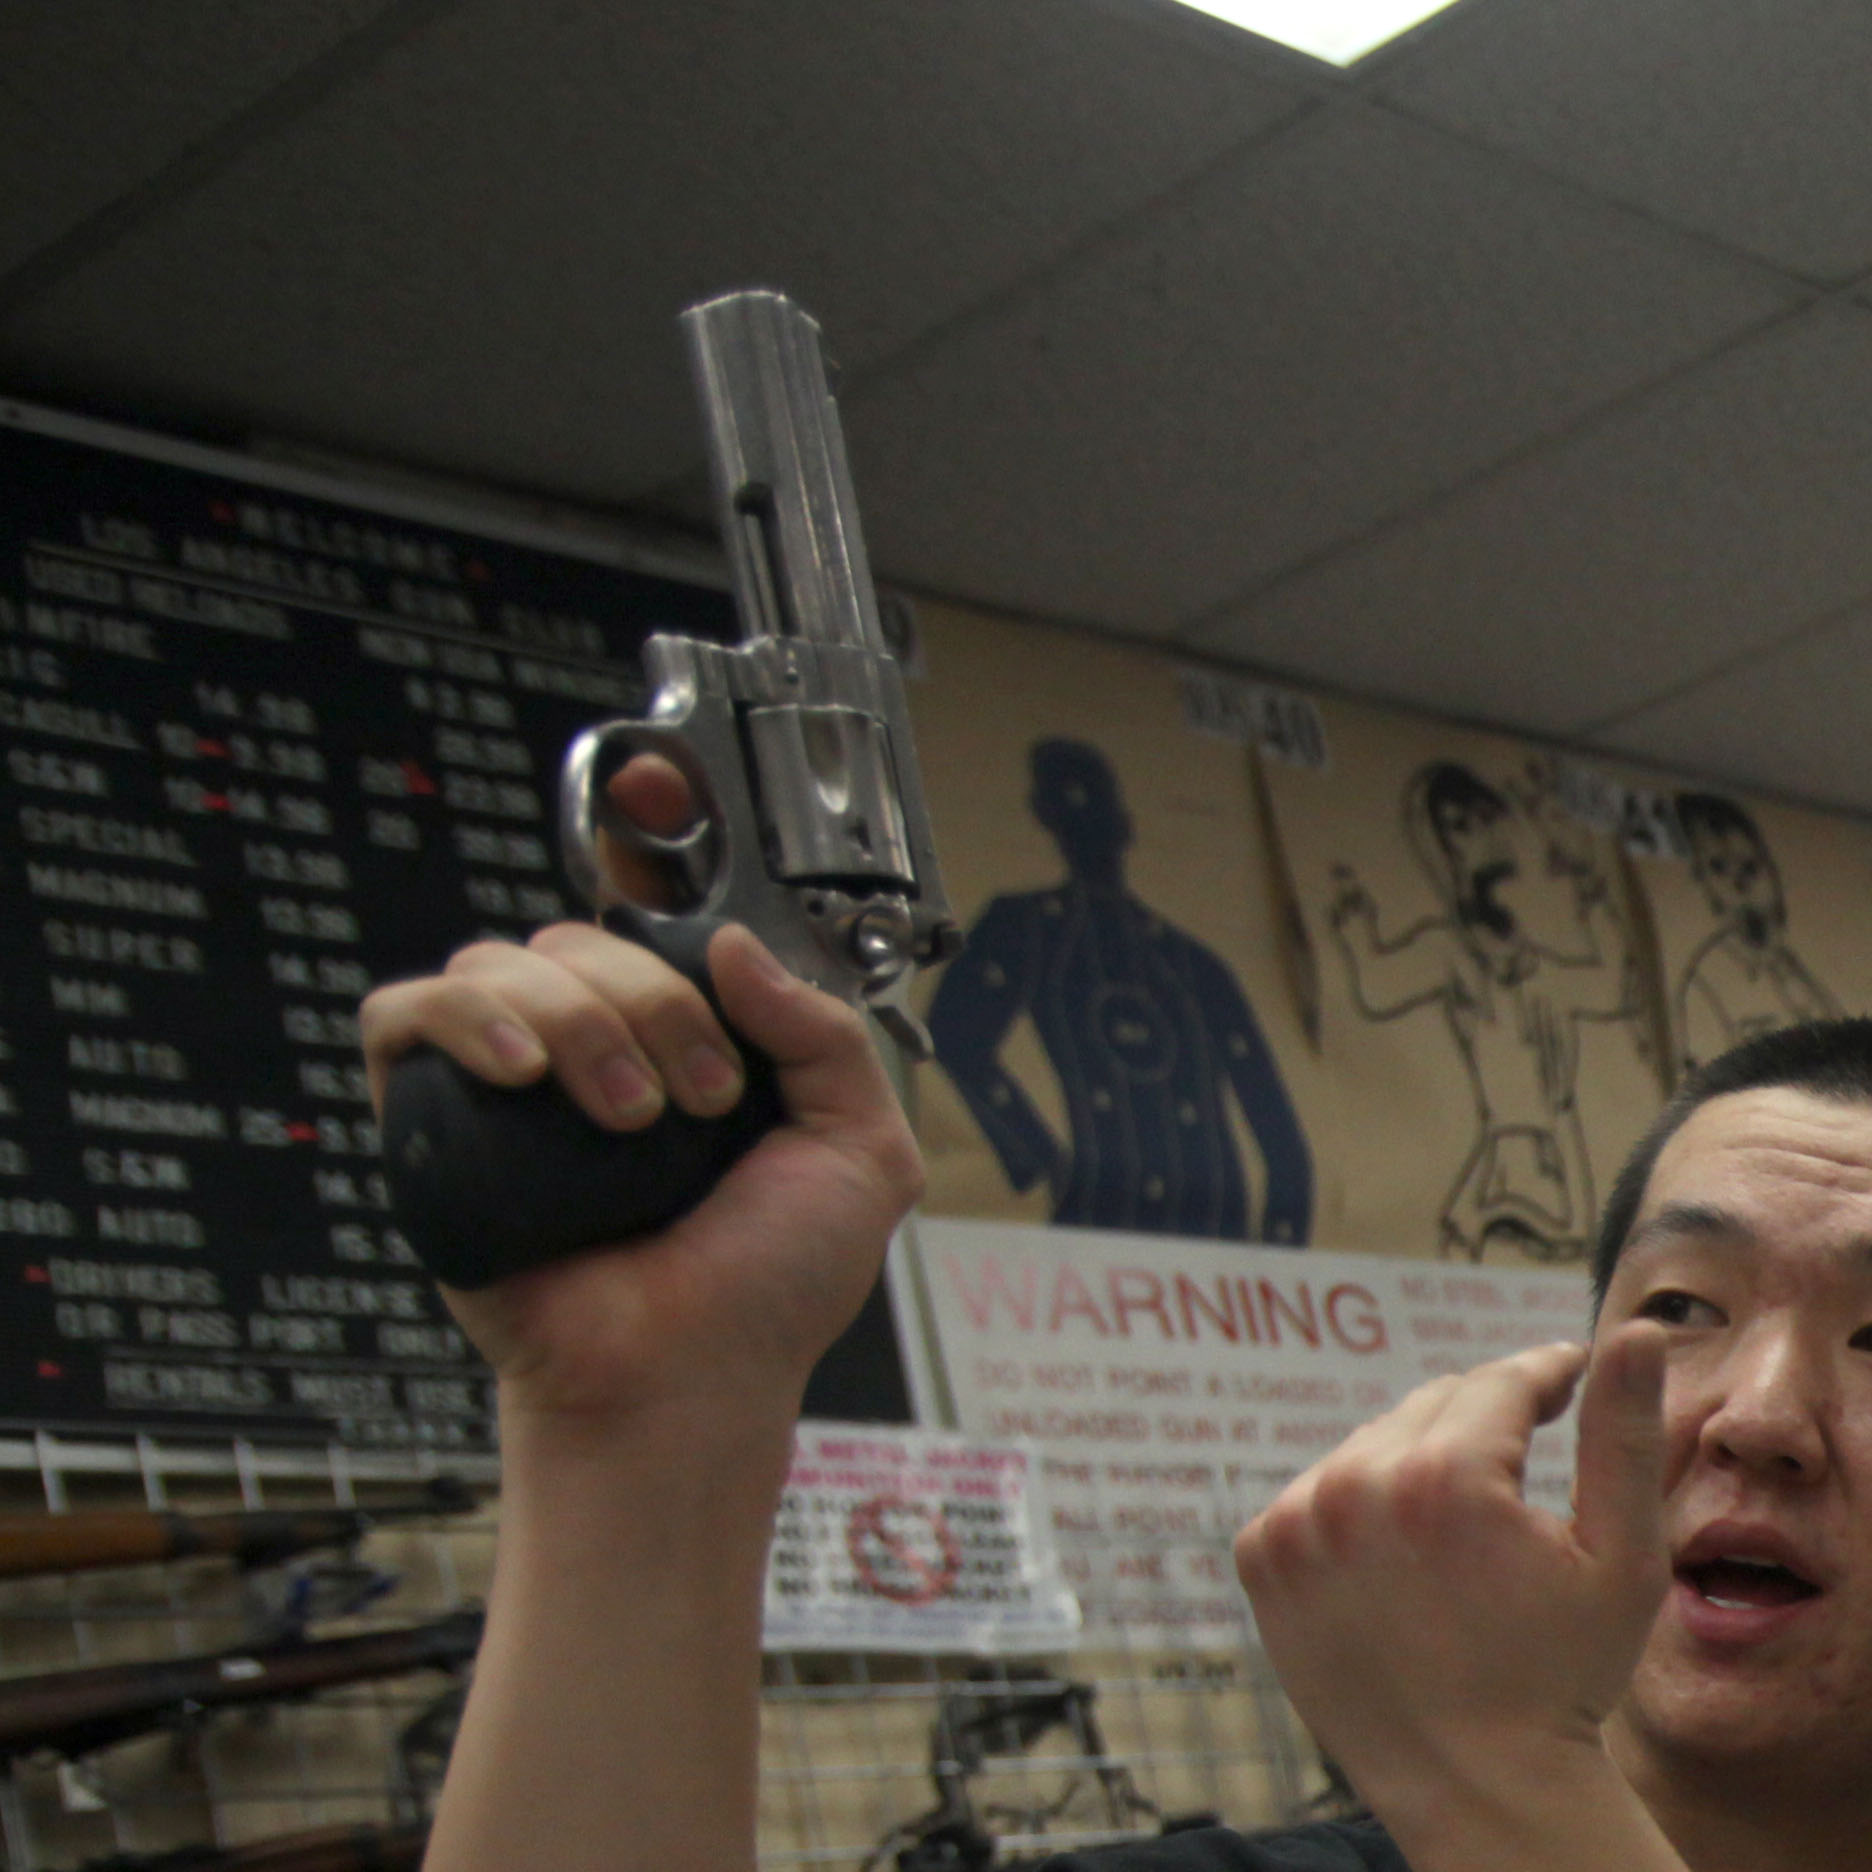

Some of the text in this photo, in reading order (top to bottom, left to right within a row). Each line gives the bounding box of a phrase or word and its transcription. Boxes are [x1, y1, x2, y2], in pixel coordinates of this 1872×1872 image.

[19, 804, 199, 867] SPECIAL
[26, 860, 209, 920] MAGNUM
[42, 917, 205, 974] SUPER
[68, 1034, 188, 1082] AUTO
[69, 1089, 228, 1139] MAGNUM
[97, 1205, 207, 1249] AUTO
[942, 1248, 1390, 1354] WARNING
[1107, 1365, 1192, 1395] POINT
[990, 1409, 1150, 1439] UNLOADED
